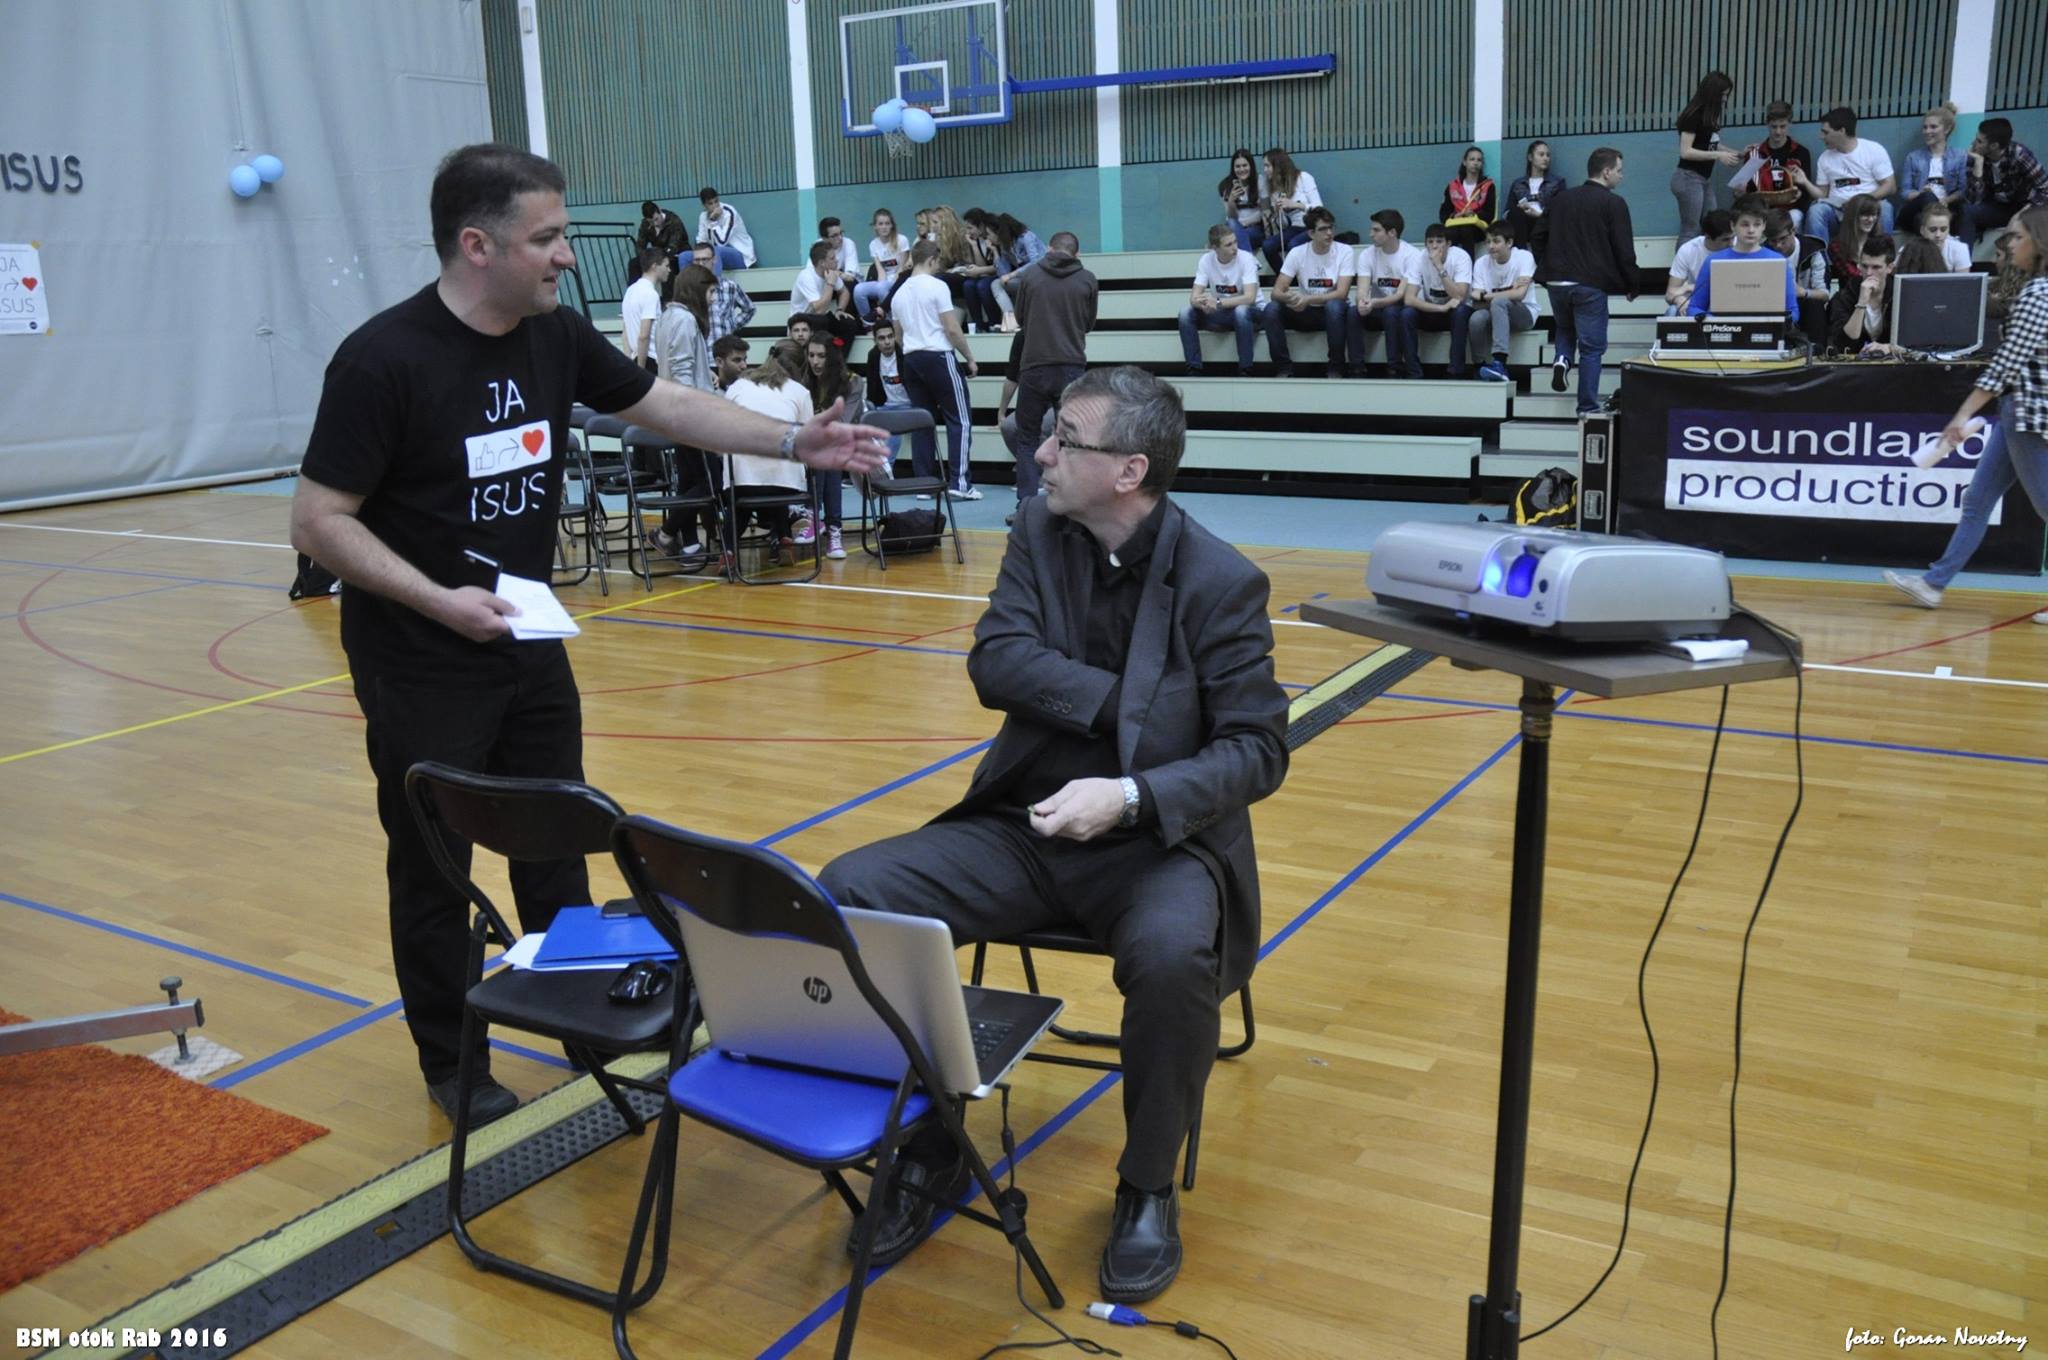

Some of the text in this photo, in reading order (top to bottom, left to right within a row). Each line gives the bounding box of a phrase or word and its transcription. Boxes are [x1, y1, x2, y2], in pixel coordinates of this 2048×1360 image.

[0, 152, 83, 194] ISUS
[0, 298, 35, 313] SUS
[486, 379, 525, 422] JA
[472, 472, 546, 522] ISUS
